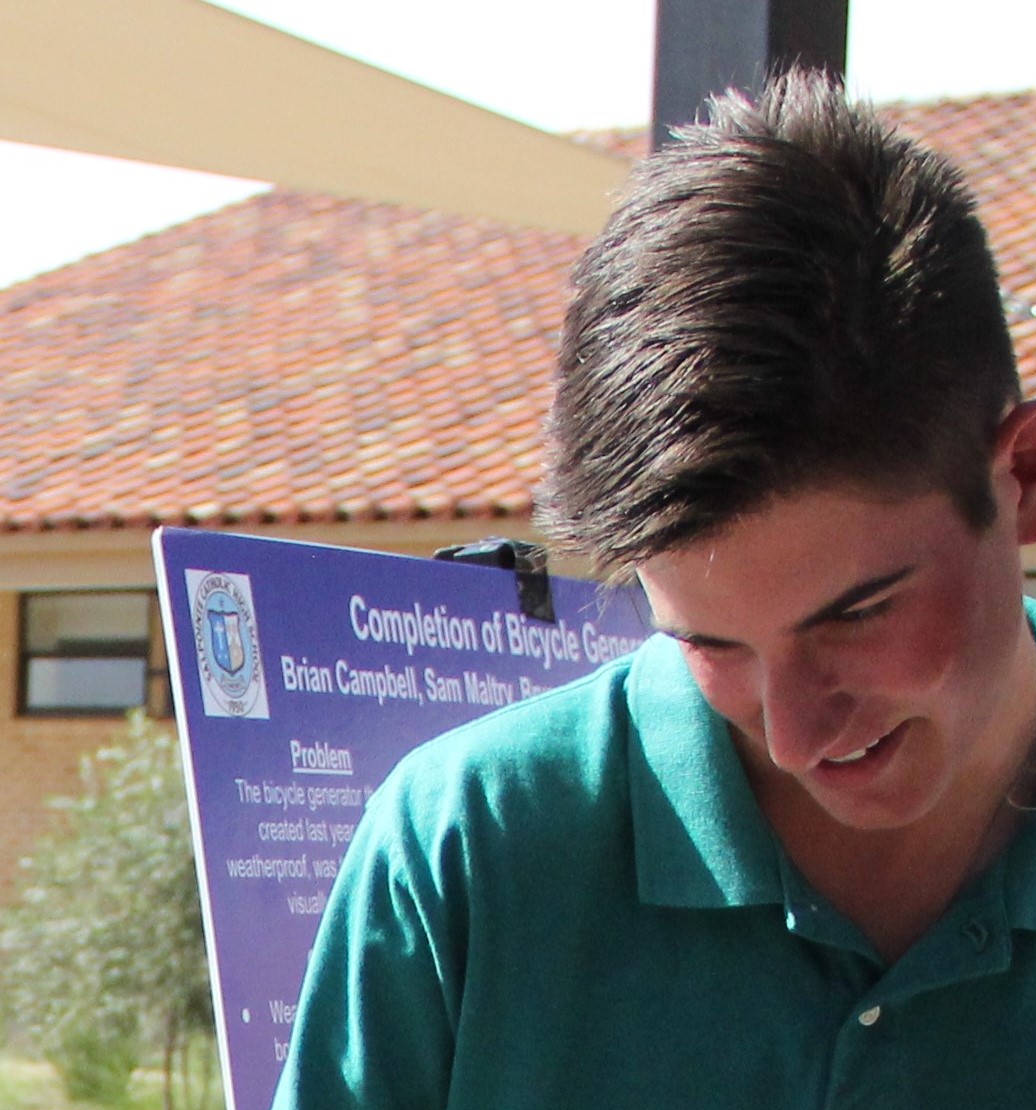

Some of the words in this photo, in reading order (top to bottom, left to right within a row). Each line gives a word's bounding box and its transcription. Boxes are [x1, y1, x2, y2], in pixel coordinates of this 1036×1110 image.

[350, 594, 477, 655] Completion
[481, 611, 501, 653] of
[506, 613, 580, 669] Bicycle
[280, 655, 333, 693] Brian
[335, 659, 423, 706] Campbell,
[424, 667, 462, 703] Sam
[290, 740, 352, 770] Problem
[235, 779, 261, 803] The
[263, 781, 305, 811] bicycle
[307, 786, 362, 811] generator
[258, 818, 304, 841] created
[305, 818, 328, 841] last
[226, 854, 311, 883] weatherproof,
[312, 859, 337, 878] was
